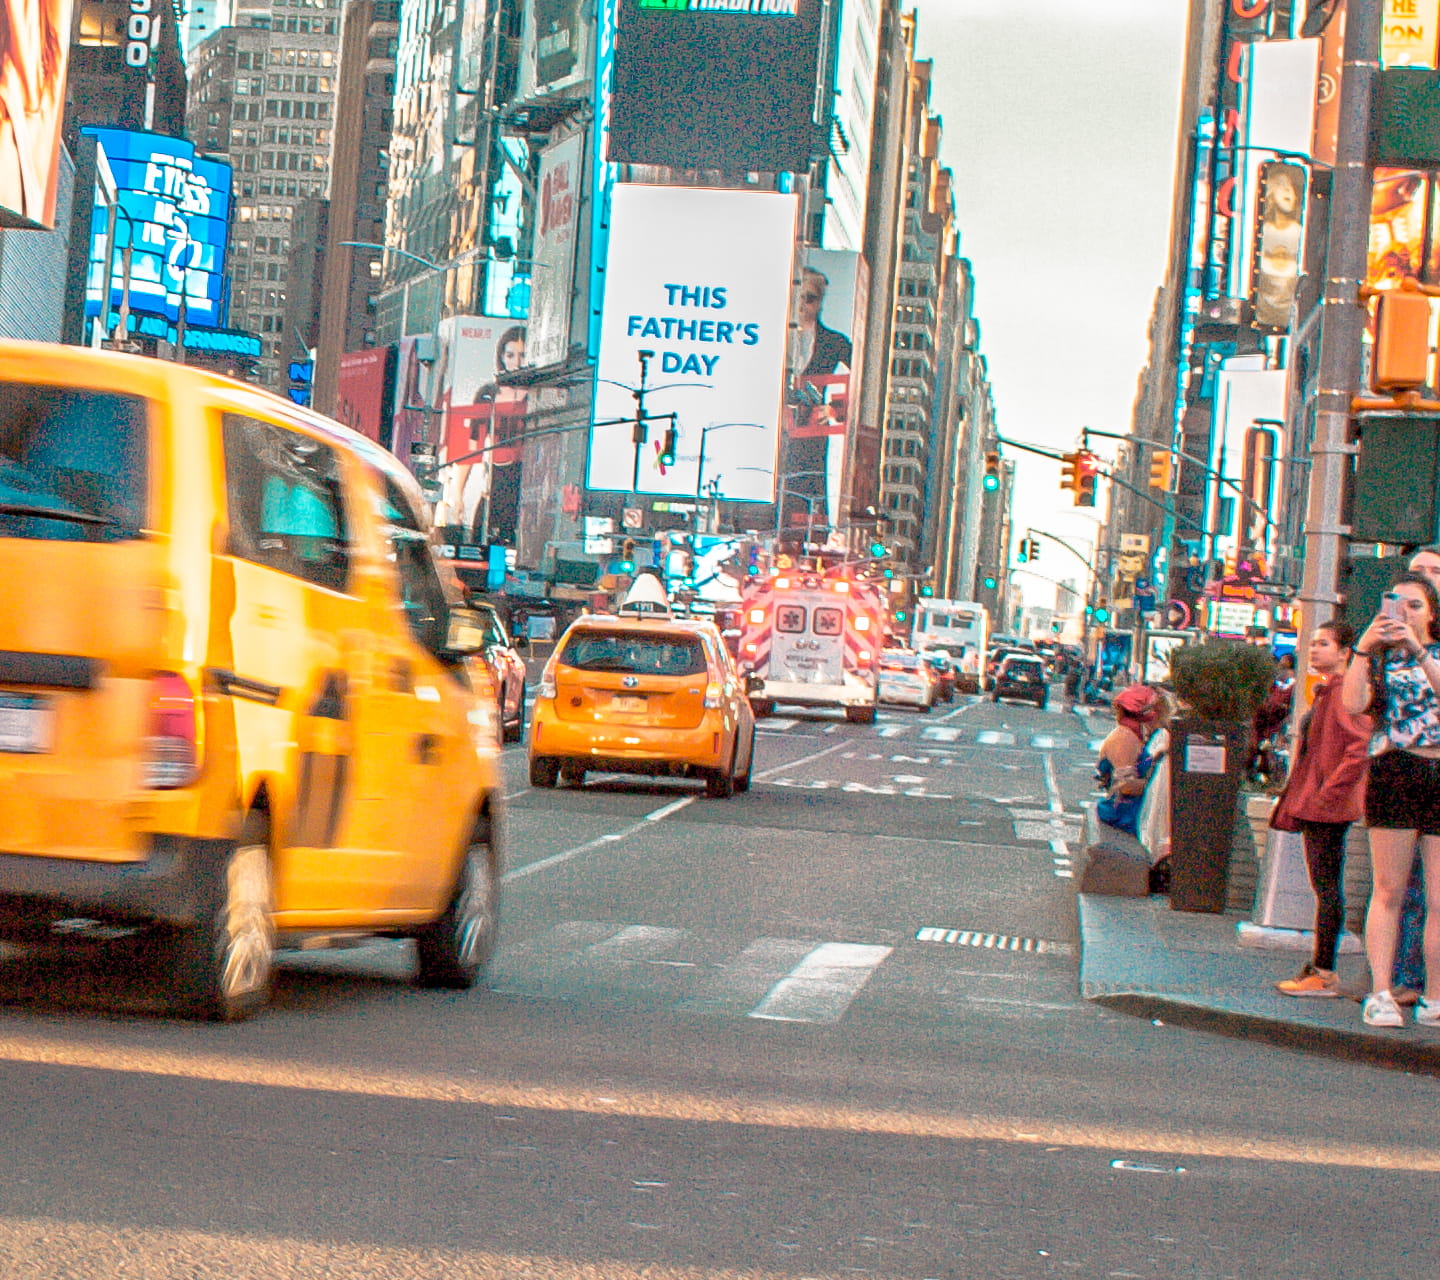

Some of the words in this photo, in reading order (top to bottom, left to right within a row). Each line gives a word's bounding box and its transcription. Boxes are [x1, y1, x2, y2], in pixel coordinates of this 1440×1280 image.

[663, 283, 727, 310] THIS
[627, 315, 760, 347] FATHER'S
[662, 350, 720, 377] DAY
